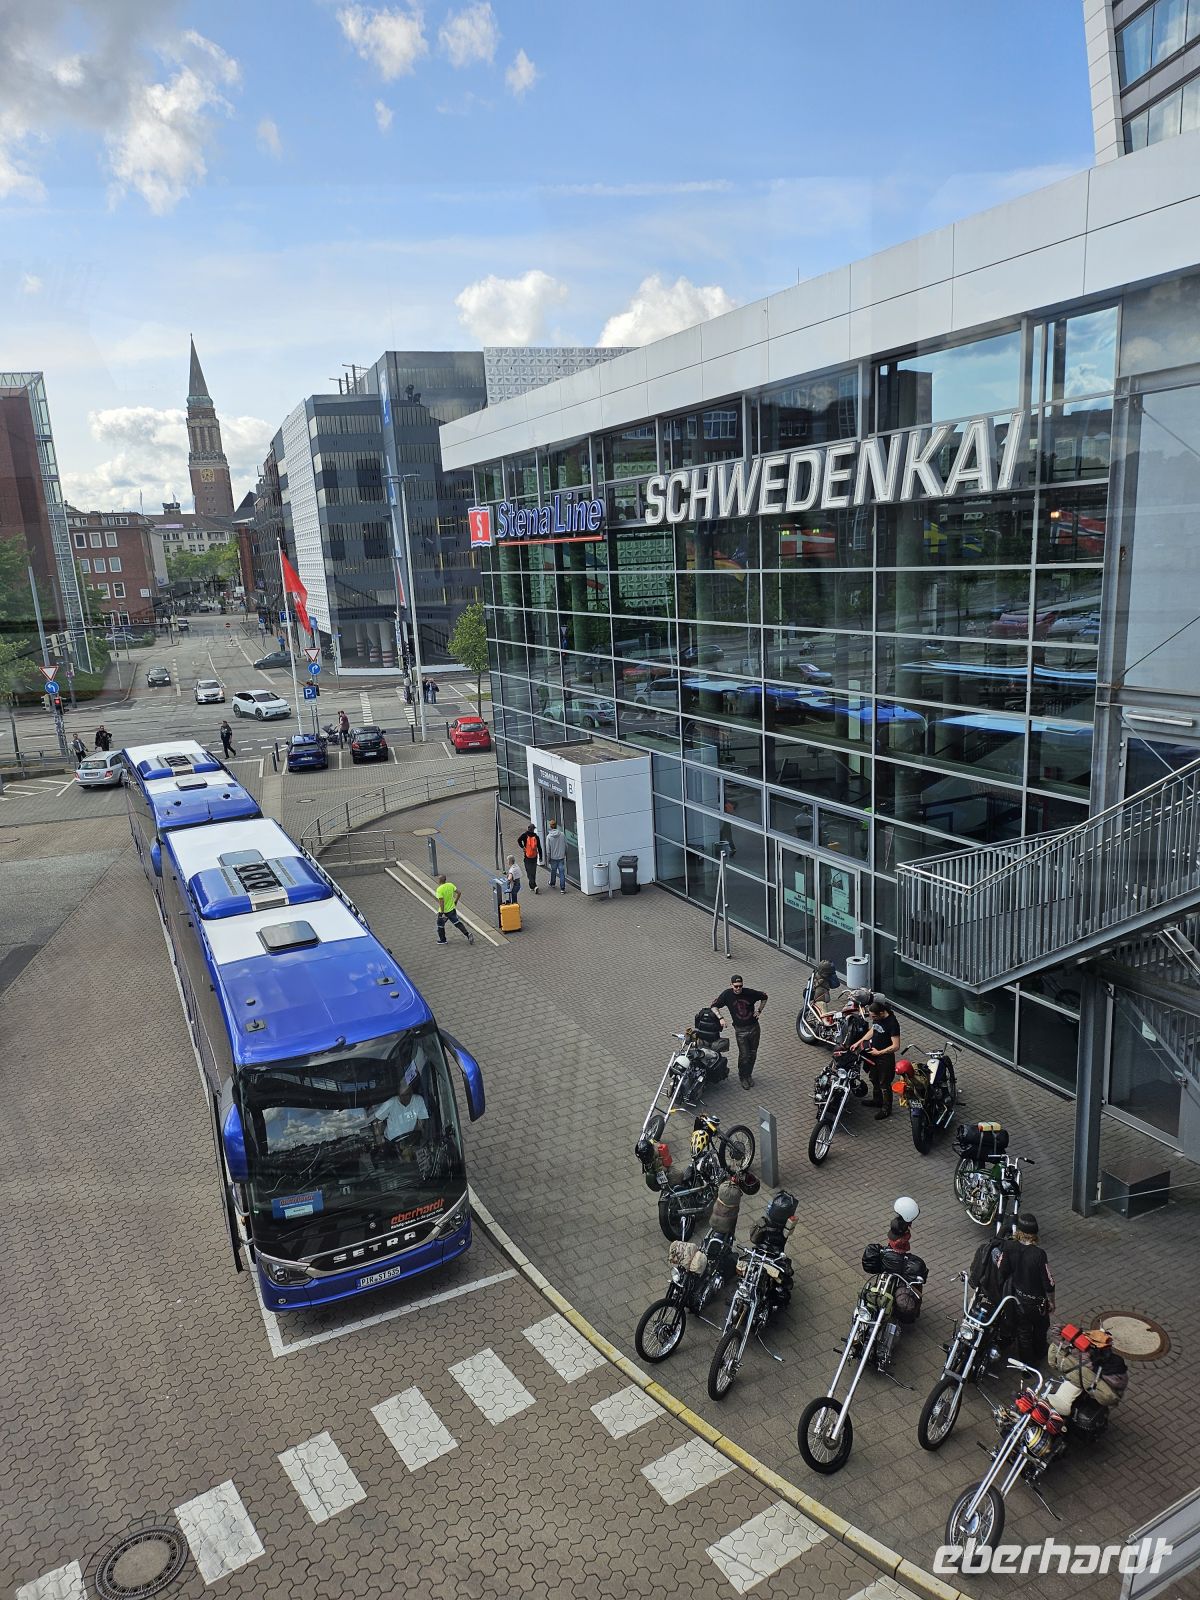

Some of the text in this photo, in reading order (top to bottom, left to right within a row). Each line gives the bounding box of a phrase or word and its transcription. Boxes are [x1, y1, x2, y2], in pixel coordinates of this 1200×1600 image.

[645, 411, 1024, 525] SCHWEDENKAI
[305, 688, 313, 698] P
[390, 1198, 445, 1225] eberhardt
[333, 1231, 416, 1263] SETRA
